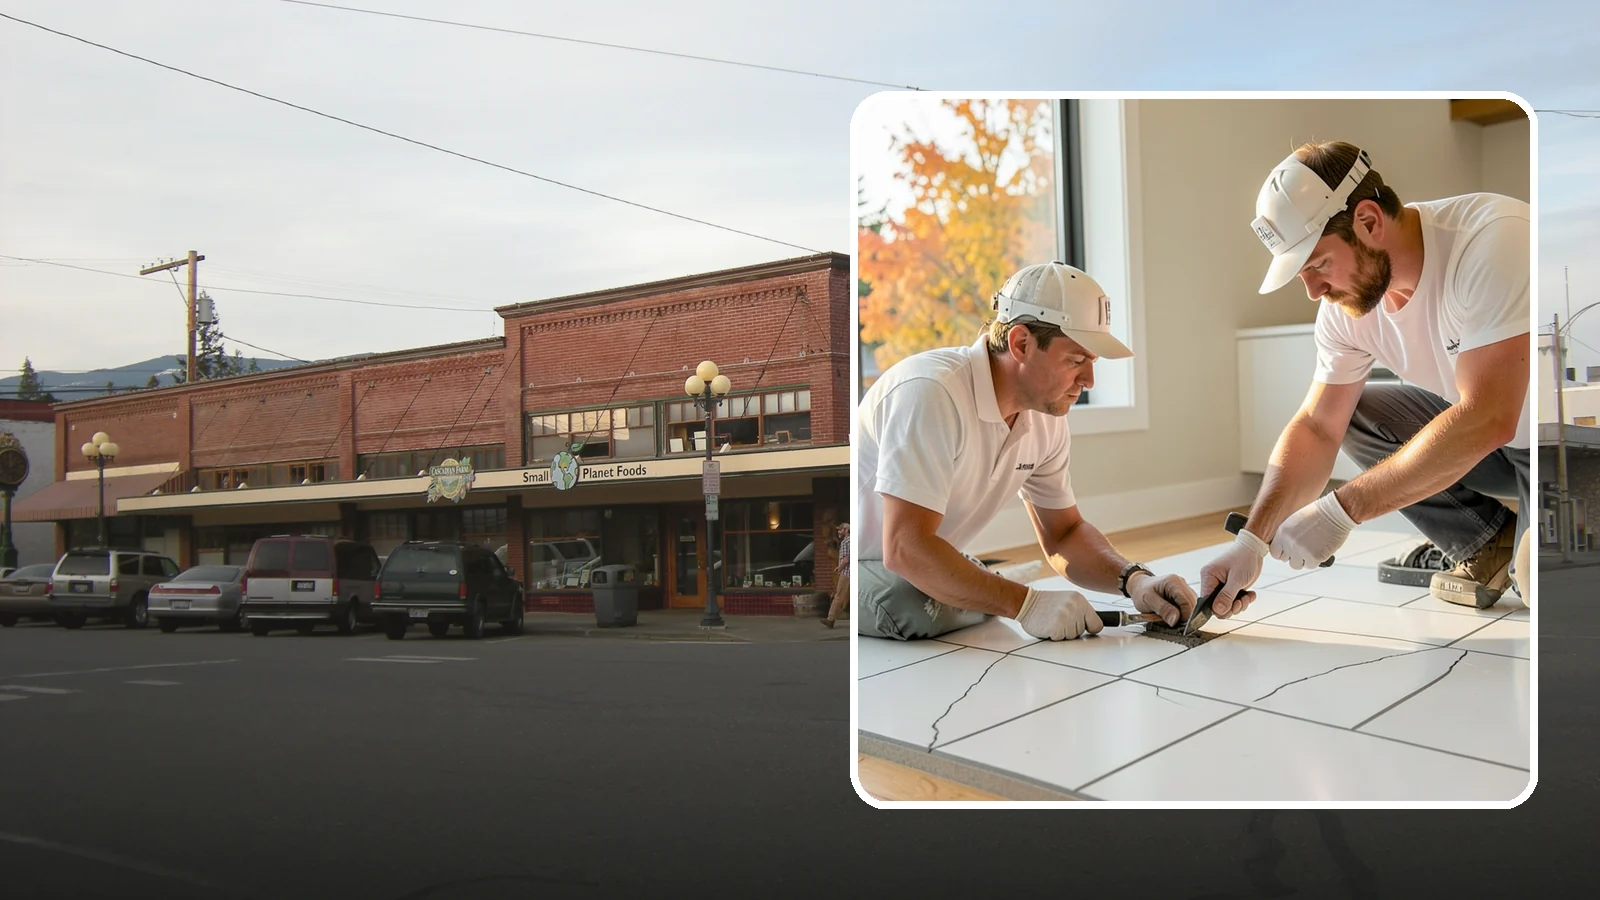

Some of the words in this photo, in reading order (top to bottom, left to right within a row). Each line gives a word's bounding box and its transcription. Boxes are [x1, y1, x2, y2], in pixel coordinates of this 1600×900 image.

[523, 471, 549, 483] Small
[583, 467, 614, 479] Planet
[617, 464, 647, 477] Foods
